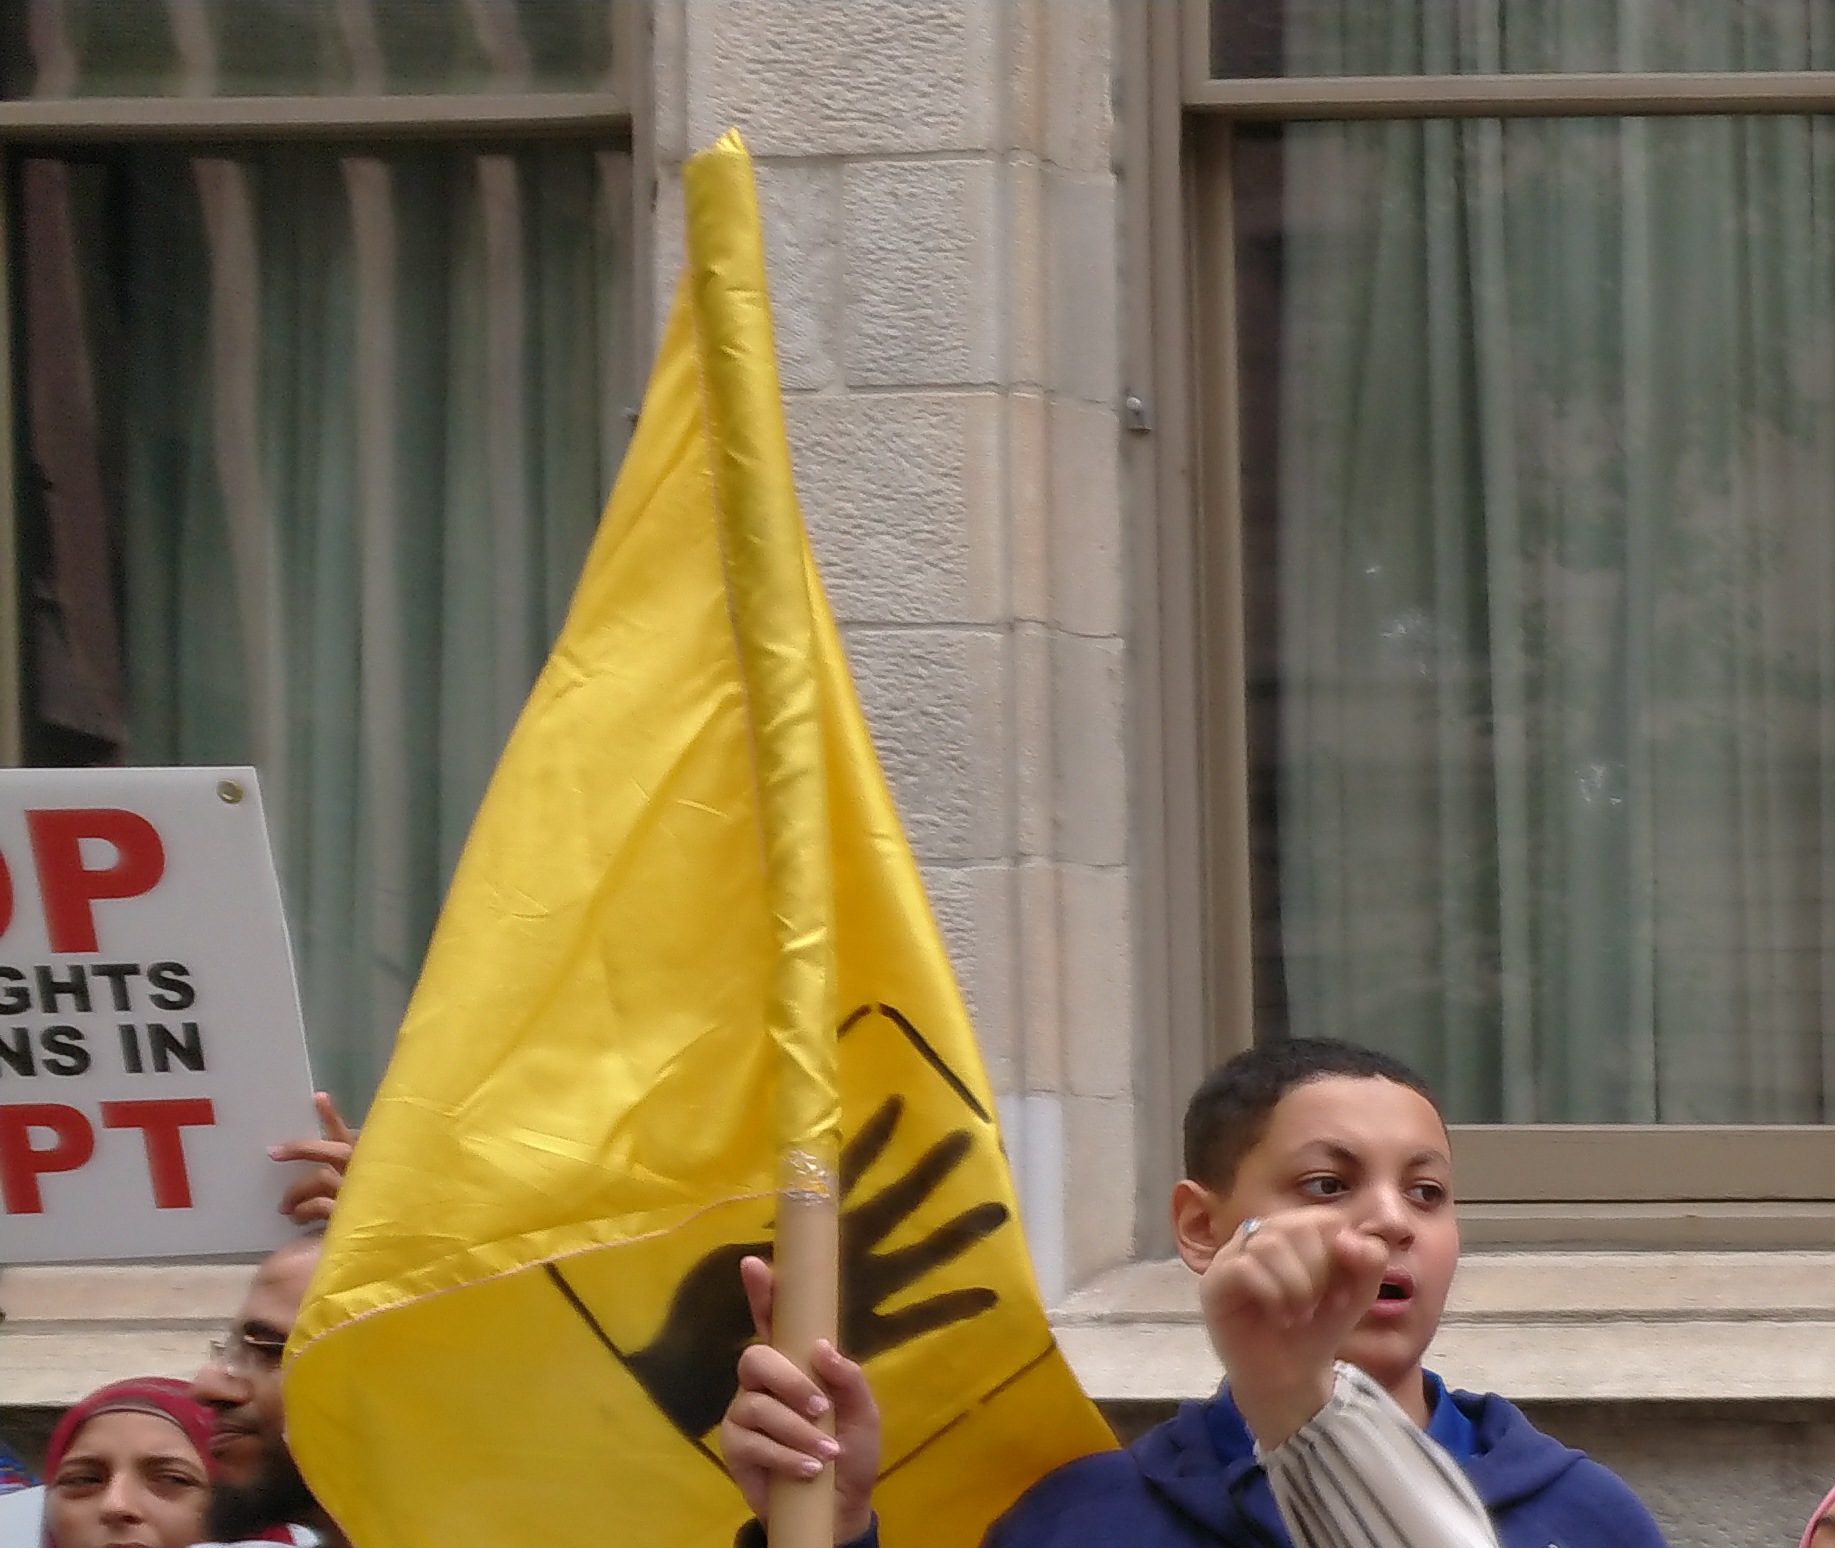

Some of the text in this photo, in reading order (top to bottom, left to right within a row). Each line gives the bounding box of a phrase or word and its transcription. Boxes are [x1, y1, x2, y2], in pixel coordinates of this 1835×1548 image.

[0, 809, 165, 953] P
[119, 1022, 206, 1073] IN
[0, 1099, 215, 1214] PT
